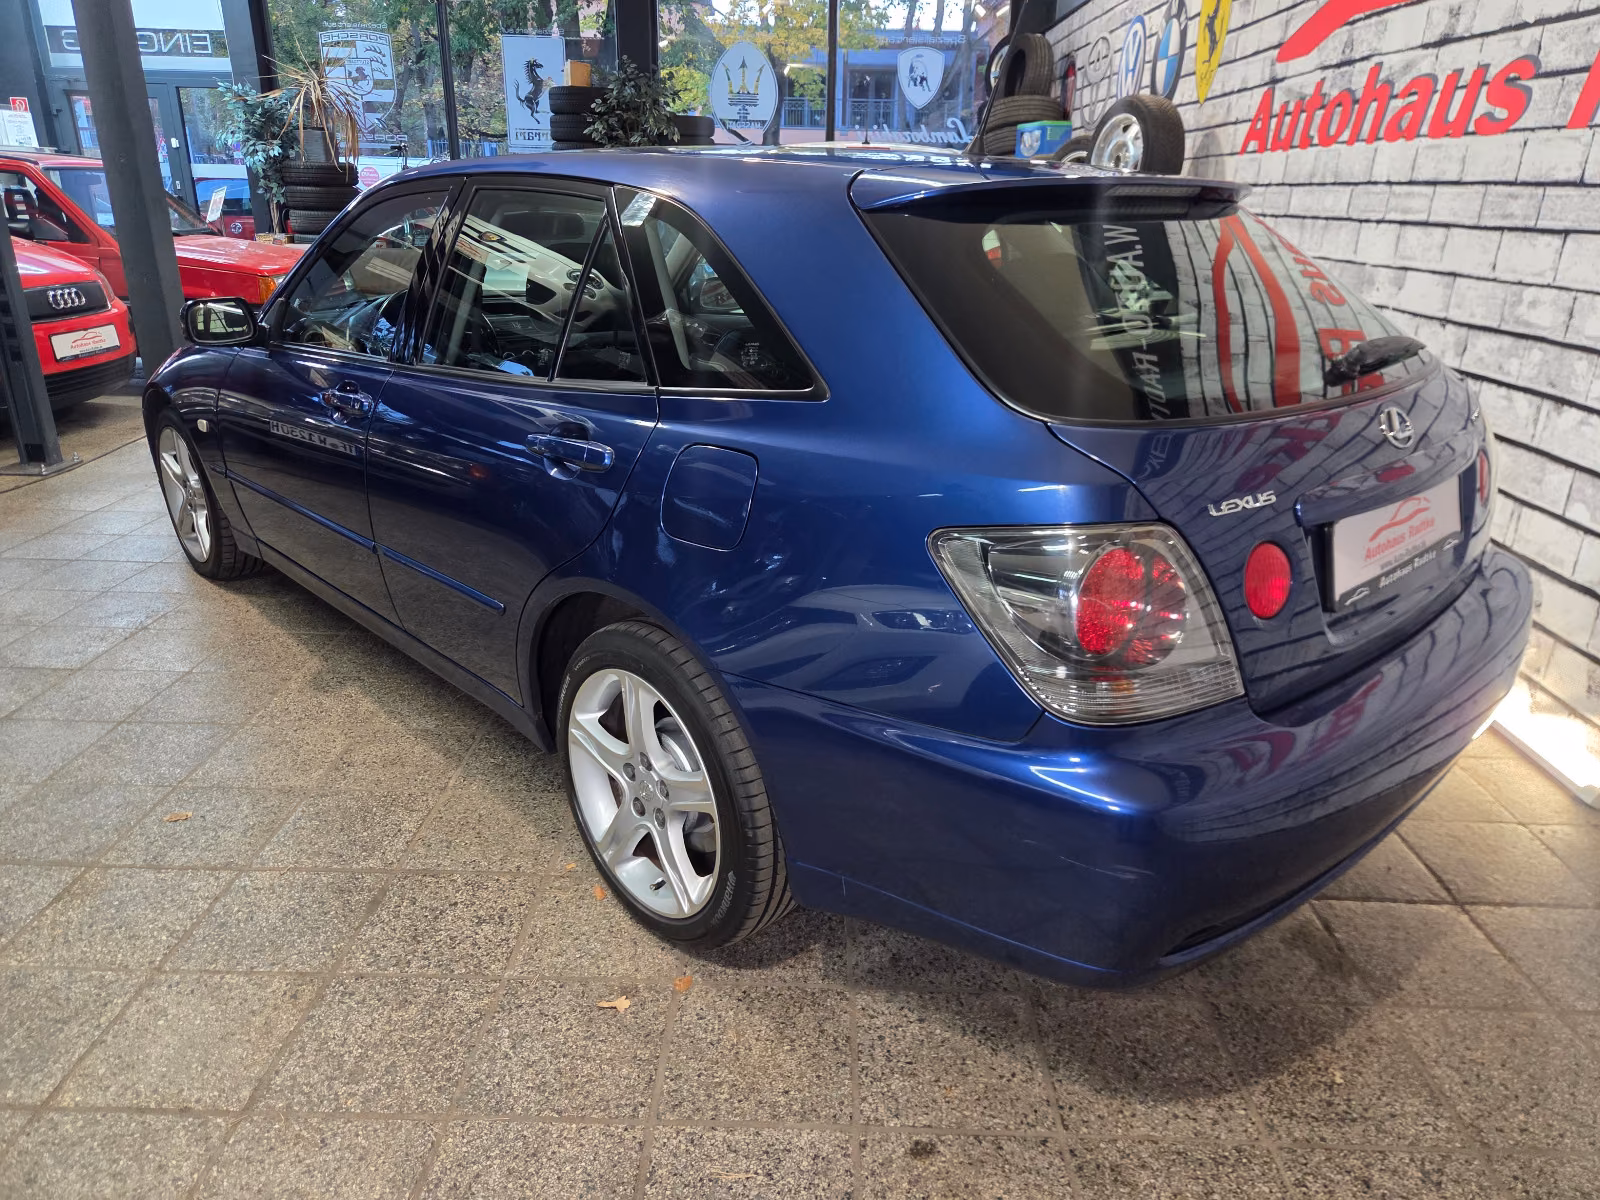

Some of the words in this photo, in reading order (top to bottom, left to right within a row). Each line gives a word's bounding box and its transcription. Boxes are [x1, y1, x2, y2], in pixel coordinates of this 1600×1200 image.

[1239, 55, 1541, 156] Autohaus
[1208, 489, 1277, 517] LEXUS
[1364, 531, 1406, 562] Autohaus
